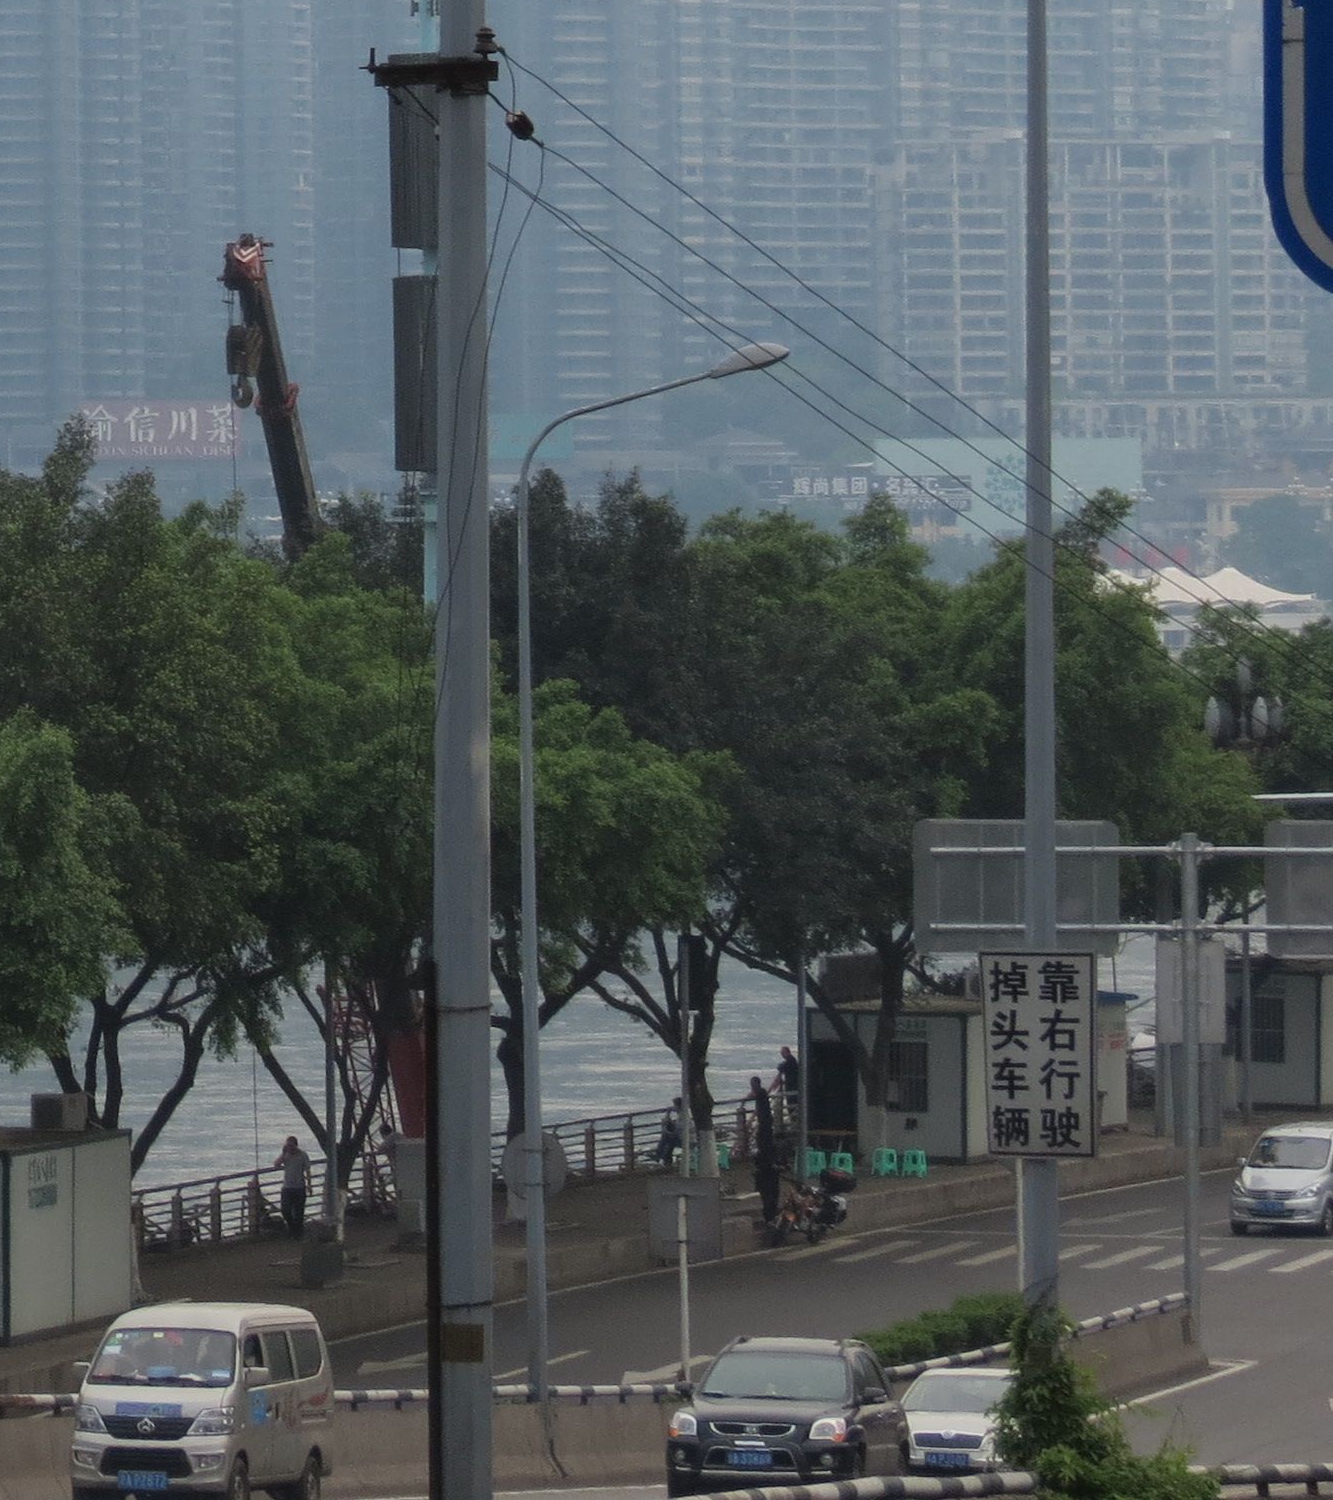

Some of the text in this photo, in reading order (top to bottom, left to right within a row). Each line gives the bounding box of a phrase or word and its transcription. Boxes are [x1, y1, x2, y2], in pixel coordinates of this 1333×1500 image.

[989, 960, 1031, 1148] 掉头车辆
[1037, 960, 1082, 1149] 靠右行驶
